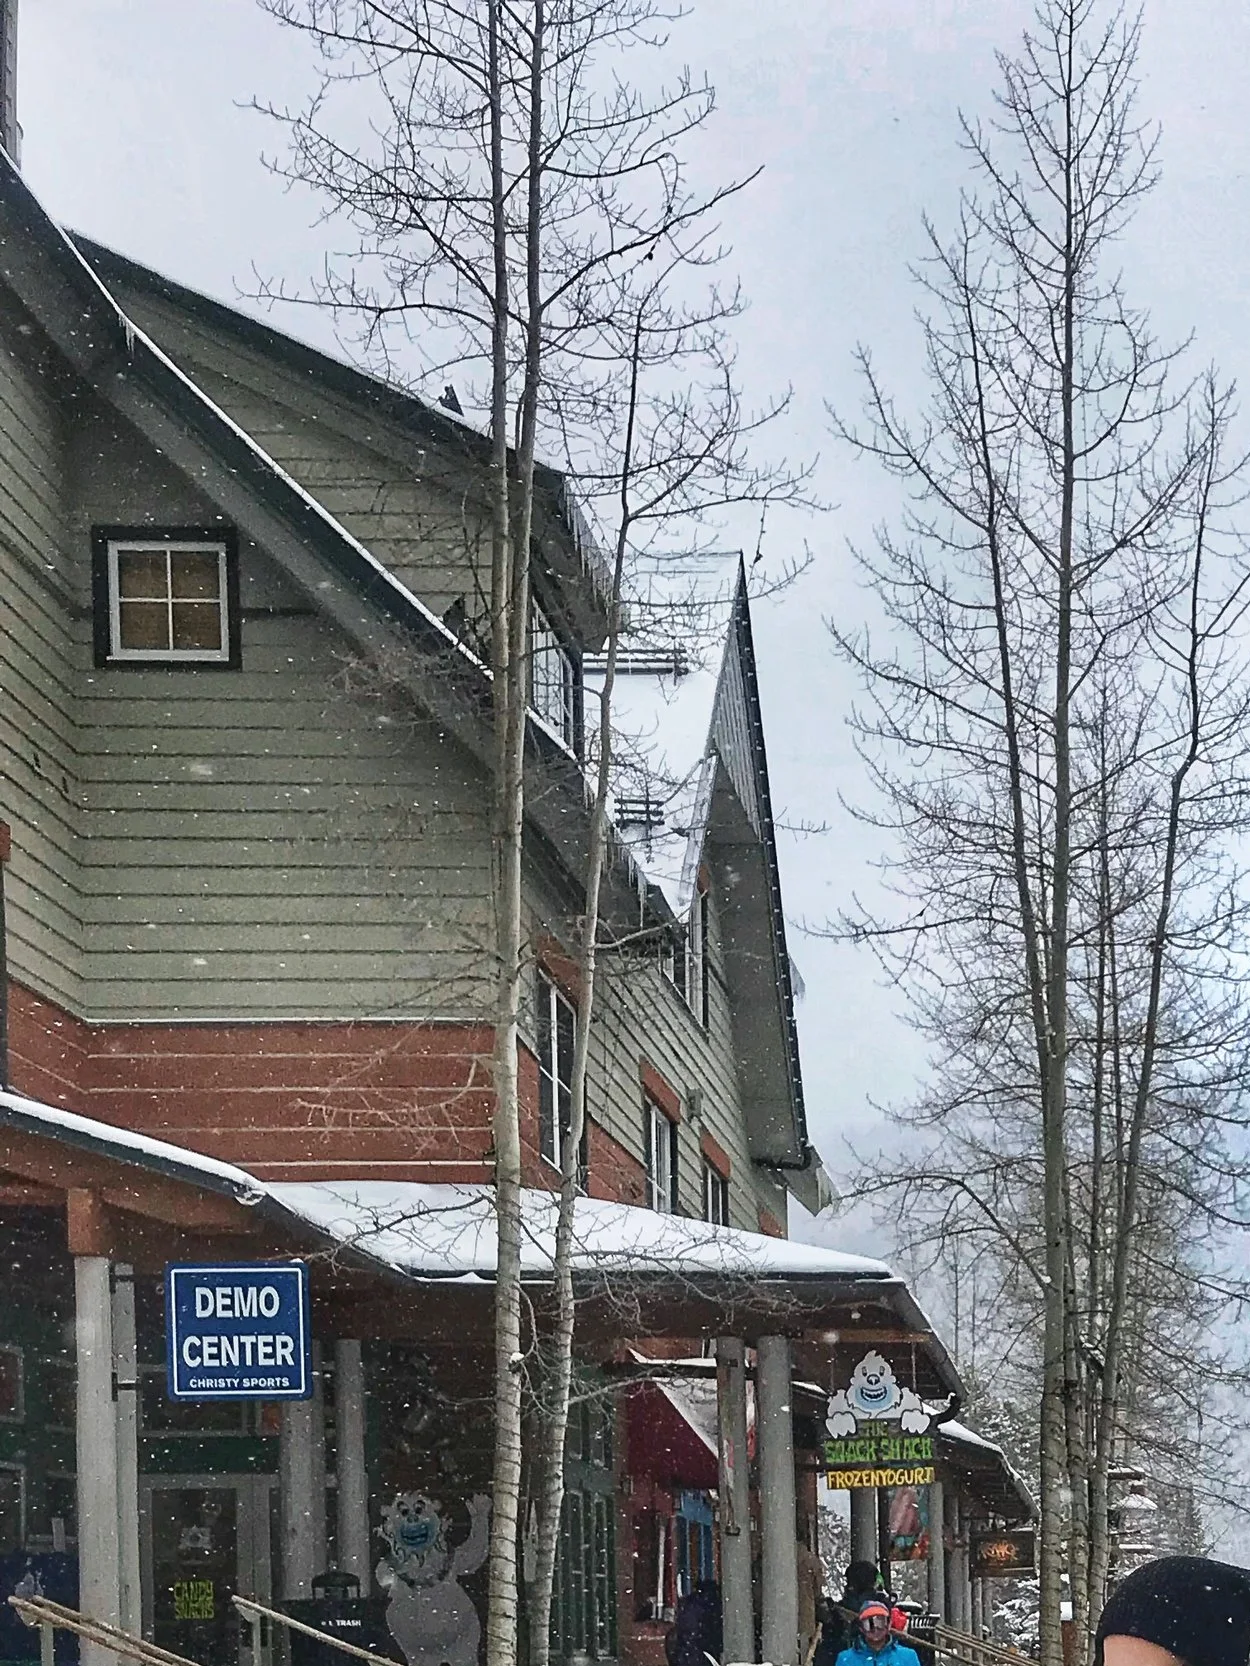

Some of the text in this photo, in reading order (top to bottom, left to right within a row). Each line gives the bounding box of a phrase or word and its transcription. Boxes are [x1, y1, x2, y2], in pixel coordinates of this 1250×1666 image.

[195, 1286, 280, 1318] DEMO
[182, 1335, 295, 1368] CENTER
[189, 1377, 290, 1388] CHRISTY SPORTS
[335, 1619, 361, 1627] TRASH
